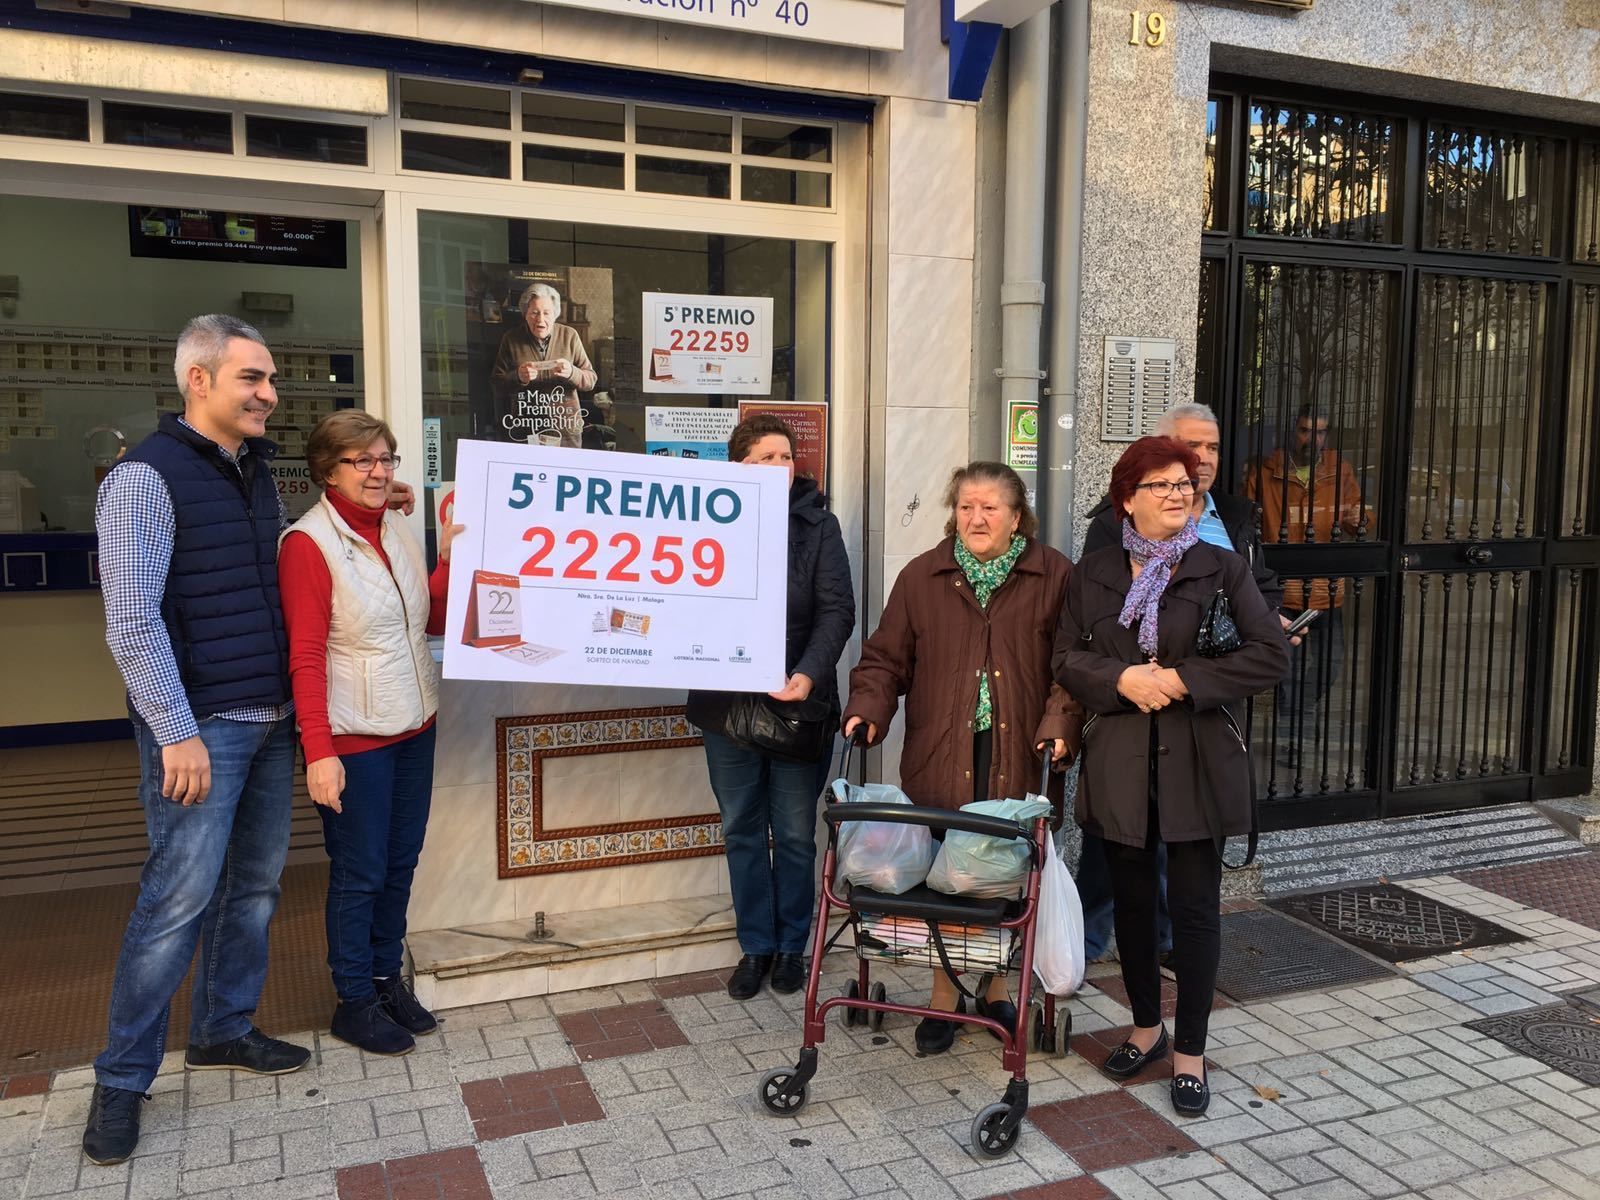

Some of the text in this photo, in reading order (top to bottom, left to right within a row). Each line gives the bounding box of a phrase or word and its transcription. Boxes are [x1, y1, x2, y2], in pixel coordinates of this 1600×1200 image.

[775, 1, 809, 26] 40
[1129, 10, 1167, 47] 19
[171, 238, 196, 246] Cuarto
[197, 241, 223, 249] premio
[265, 243, 298, 252] repartido
[283, 232, 314, 240] 60.000€
[681, 307, 755, 325] PREMIO
[670, 329, 749, 353] 22259
[527, 386, 565, 405] Mayor
[518, 401, 566, 418] Premio
[271, 467, 311, 477] REMIO
[277, 481, 309, 494] 259
[555, 474, 742, 524] PREMIO
[518, 526, 725, 587] 22259
[488, 590, 515, 615] 22
[584, 646, 595, 654] 22
[610, 648, 653, 657] DICIEMBRE
[586, 656, 611, 664] SORTEO
